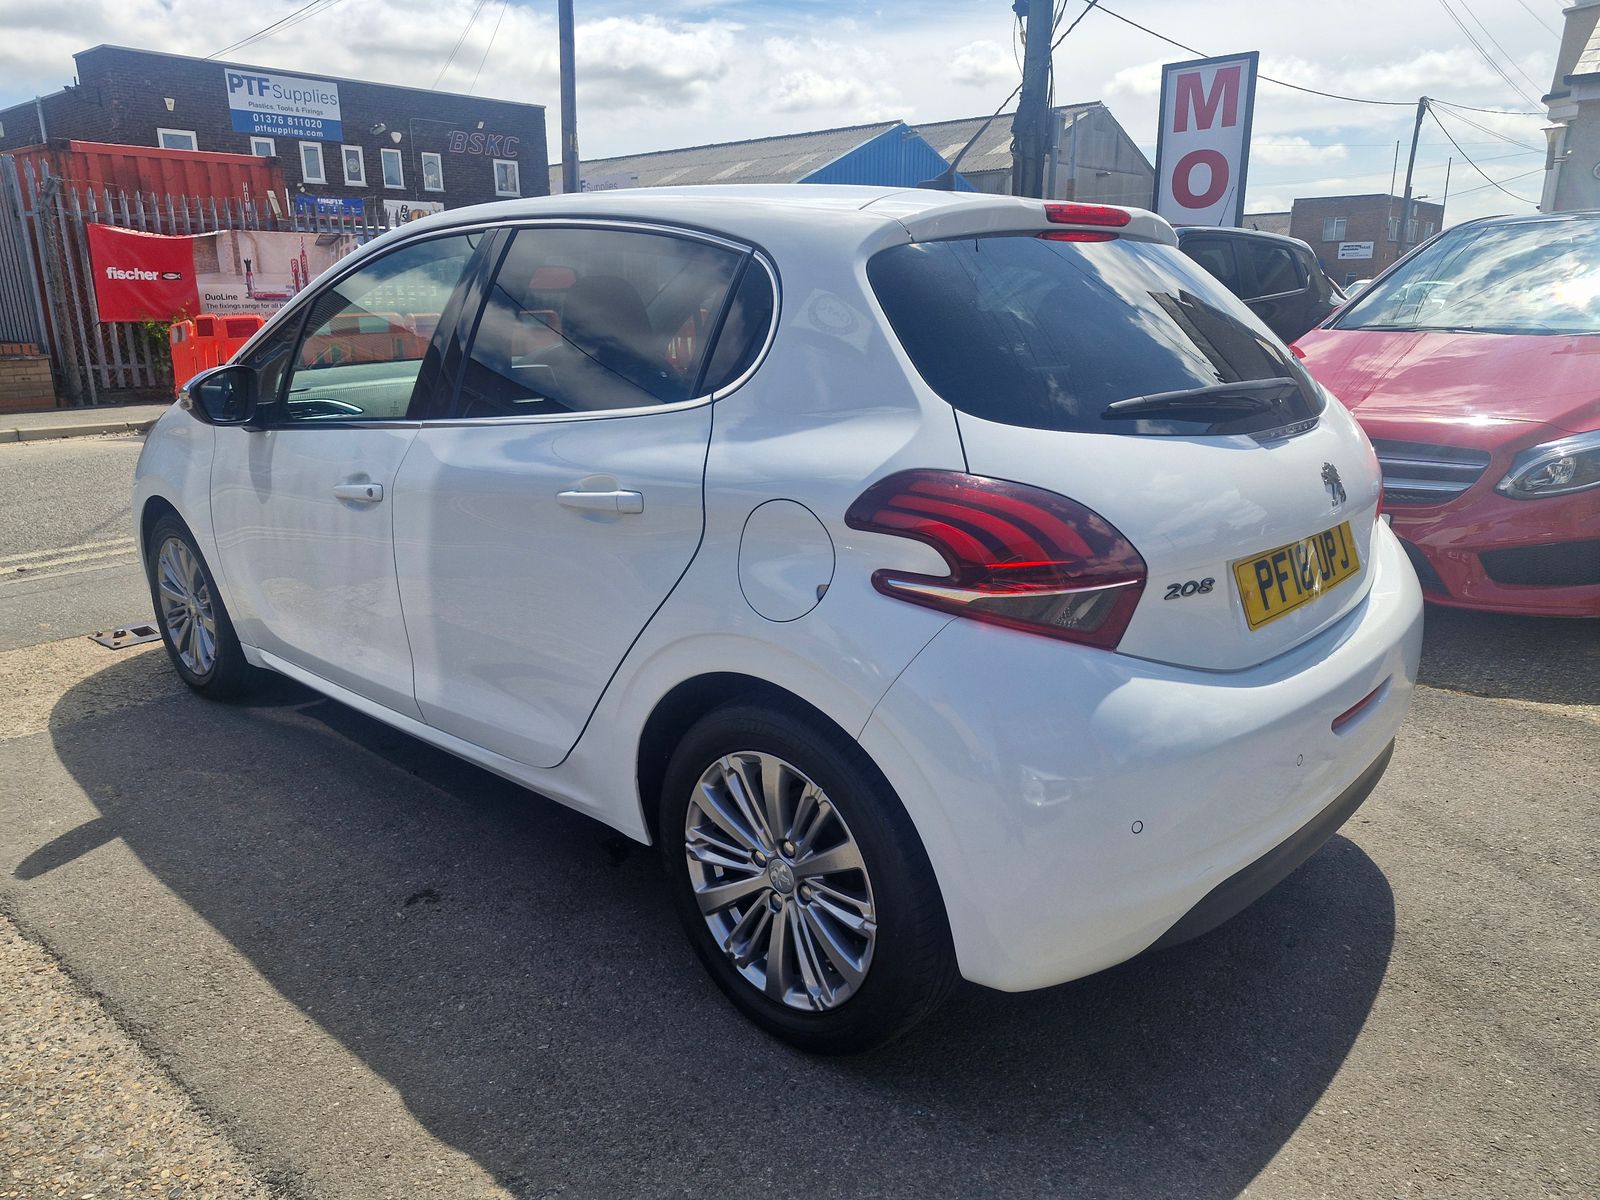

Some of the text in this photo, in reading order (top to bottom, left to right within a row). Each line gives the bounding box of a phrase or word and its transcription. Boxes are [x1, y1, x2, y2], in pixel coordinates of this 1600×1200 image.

[227, 73, 338, 105] PTF Supplies
[277, 104, 294, 112] Tools
[301, 107, 324, 116] Fixings
[253, 113, 322, 129] 01376 811020
[255, 124, 324, 137] ptfsupplies.com
[449, 130, 520, 157] BSKC
[1170, 66, 1242, 227] MO
[106, 266, 159, 281] fischer
[205, 293, 238, 301] DuoLine
[1312, 525, 1349, 579] UPJ
[1164, 577, 1216, 600] 208
